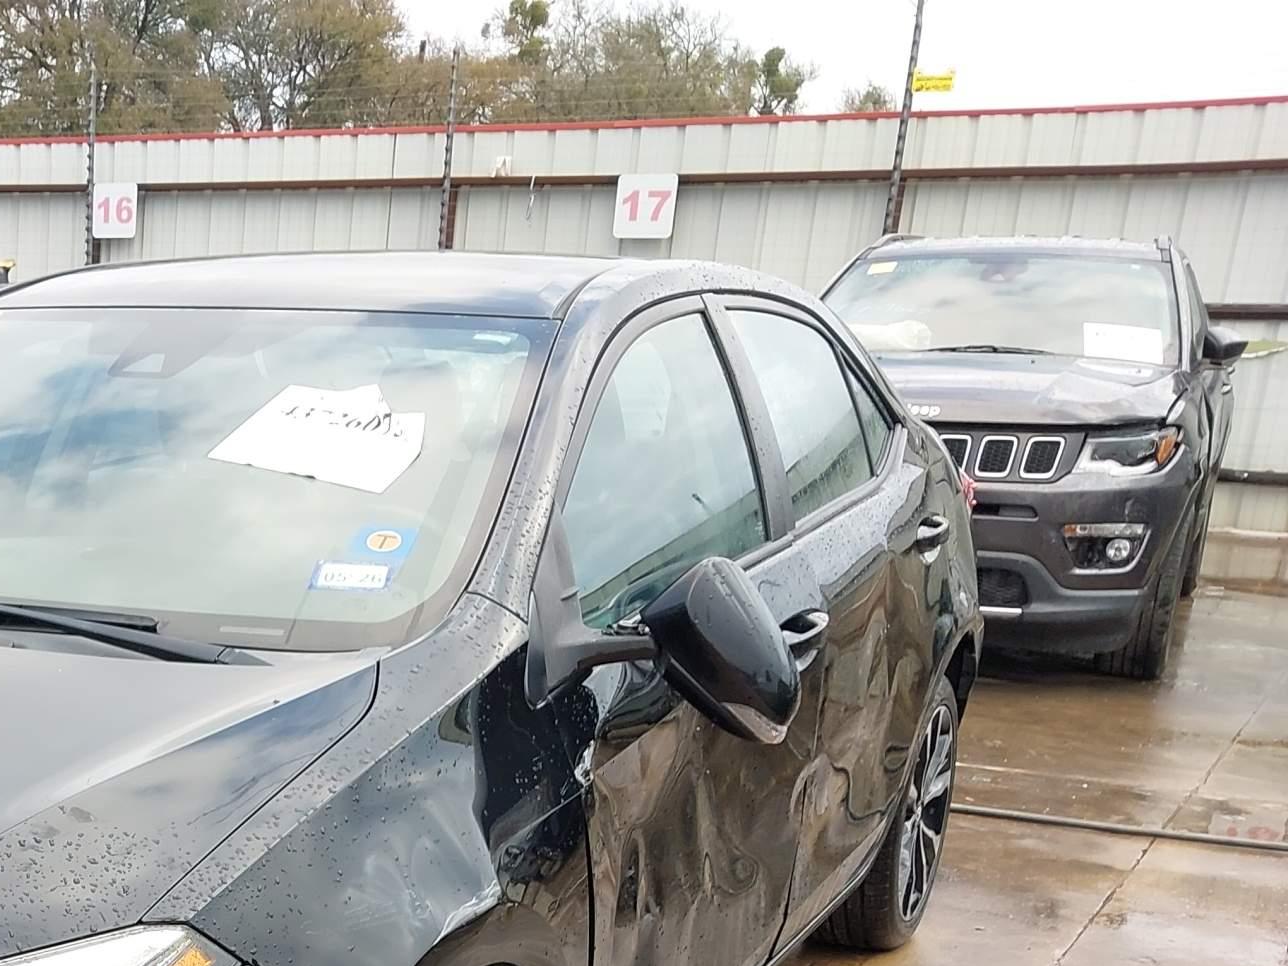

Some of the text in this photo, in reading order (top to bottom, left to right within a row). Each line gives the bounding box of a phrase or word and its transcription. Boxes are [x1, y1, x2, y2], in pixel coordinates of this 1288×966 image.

[97, 196, 133, 224] 16
[622, 189, 672, 222] 17
[377, 534, 398, 549] T
